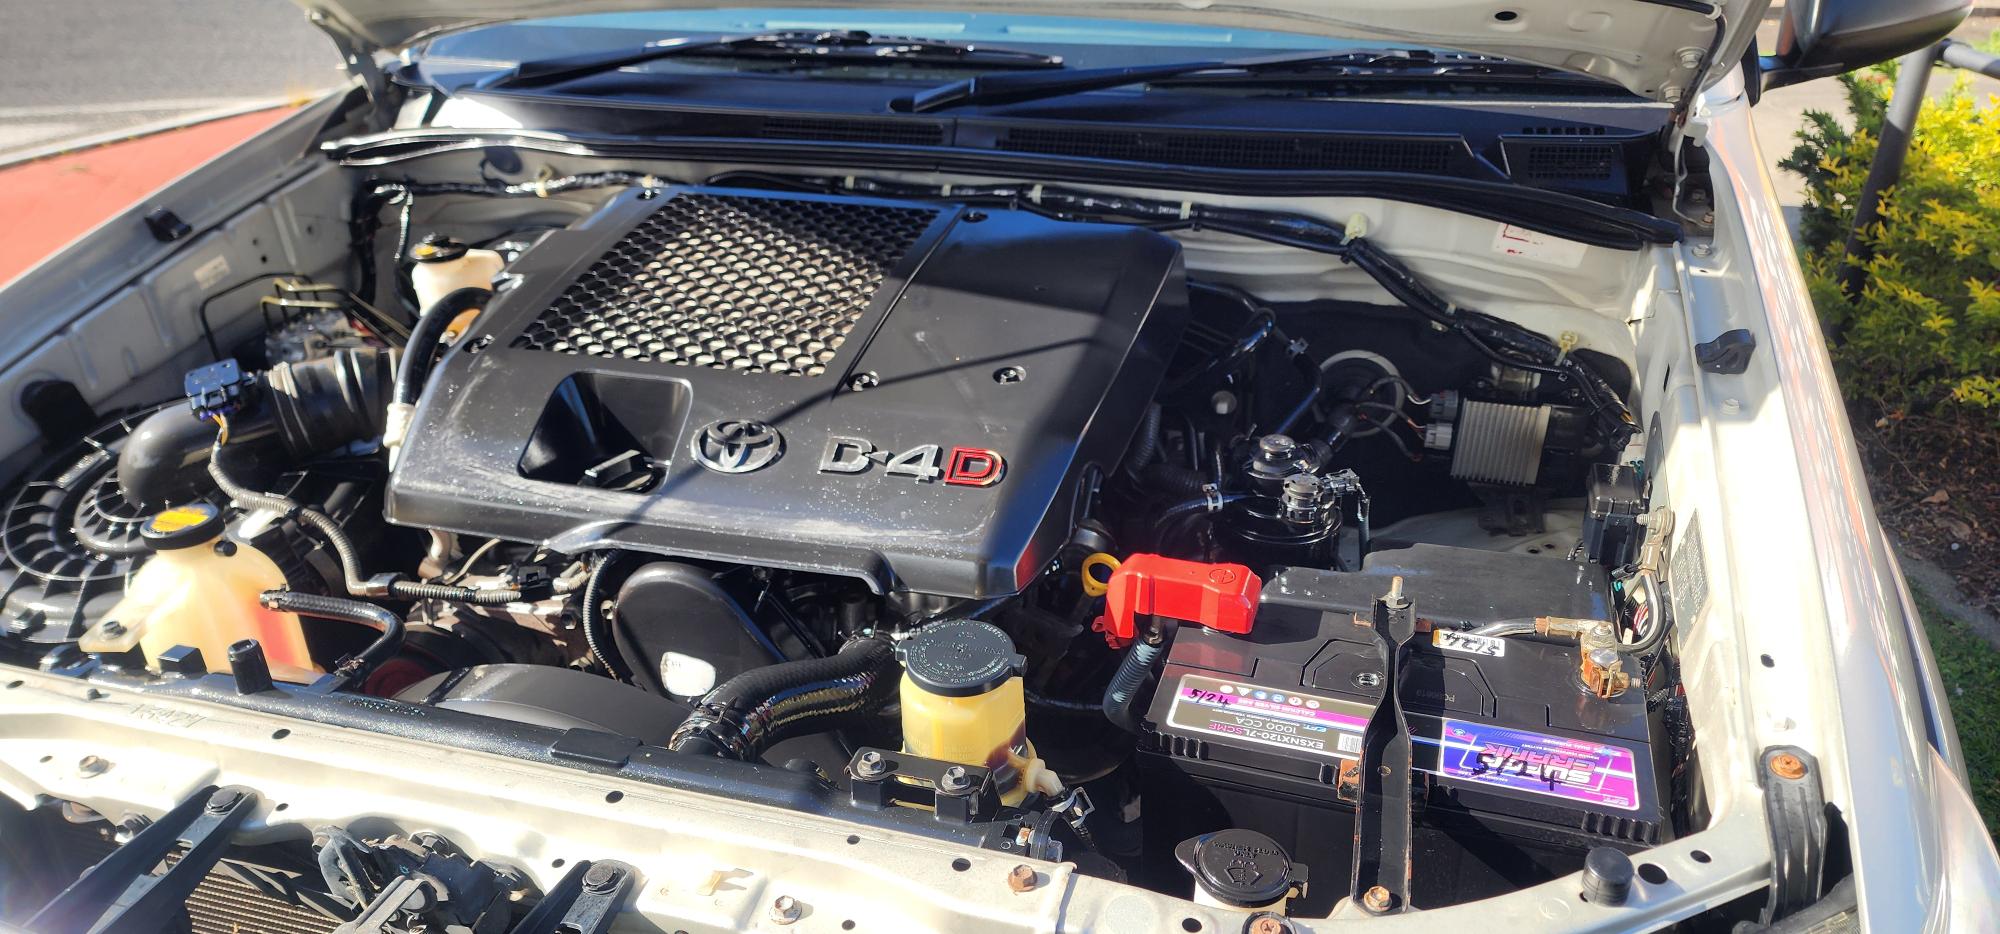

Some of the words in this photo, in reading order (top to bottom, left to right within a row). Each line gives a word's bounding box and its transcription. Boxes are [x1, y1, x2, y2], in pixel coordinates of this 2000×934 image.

[819, 434, 1004, 487] D-4D
[1187, 688, 1231, 709] 5/24
[1235, 716, 1263, 728] CCA
[1266, 721, 1297, 734] 1000
